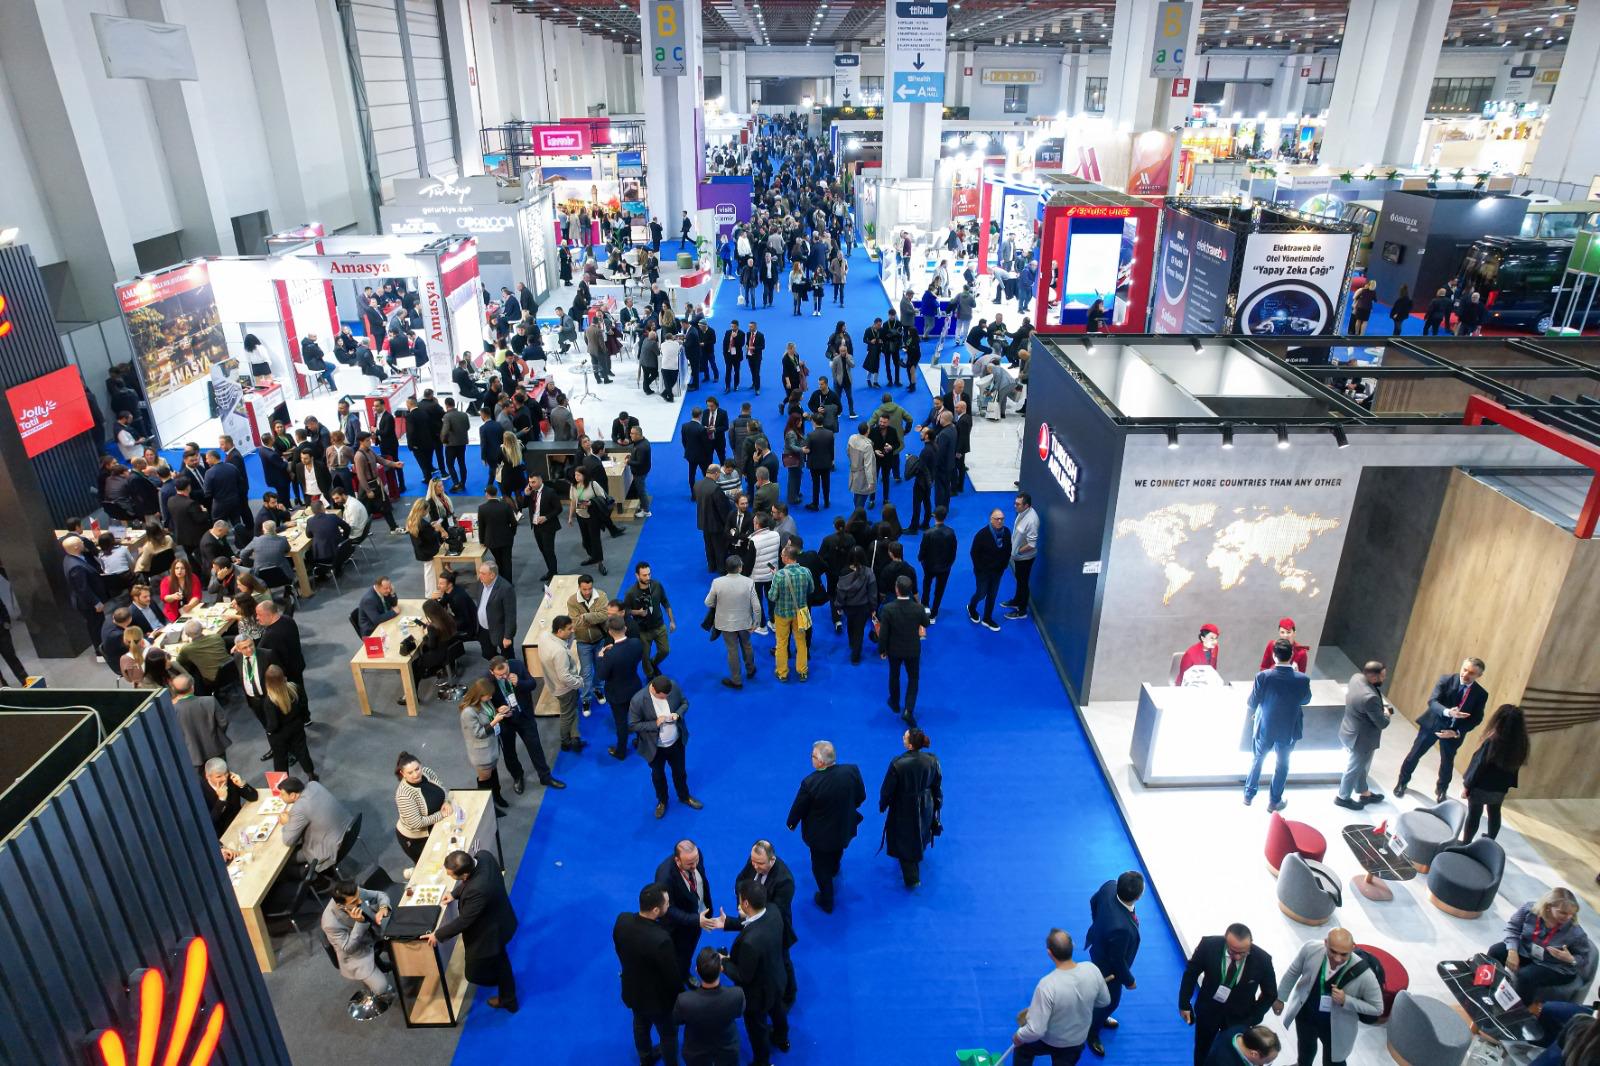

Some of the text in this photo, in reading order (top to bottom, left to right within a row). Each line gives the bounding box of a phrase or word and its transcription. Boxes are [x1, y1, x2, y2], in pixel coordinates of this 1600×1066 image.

[656, 5, 676, 37] B
[1163, 6, 1184, 37] B
[655, 46, 683, 61] a c
[1156, 48, 1184, 63] a c
[917, 86, 927, 97] A
[1196, 240, 1223, 259] elektraweb
[1273, 244, 1322, 252] Elektraweb ile
[1266, 254, 1325, 263] Otel Yönetiminde
[330, 261, 390, 276] Amasya
[1286, 266, 1307, 275] Zeka
[425, 281, 443, 343] Amasya
[167, 355, 211, 388] AMASYA
[19, 403, 50, 421] Jolly
[19, 415, 39, 431] Tatil
[1051, 433, 1078, 484] TURKISH
[1134, 478, 1342, 487] WE CONNECT MORE COUNTRIES THAN ANY OTHER
